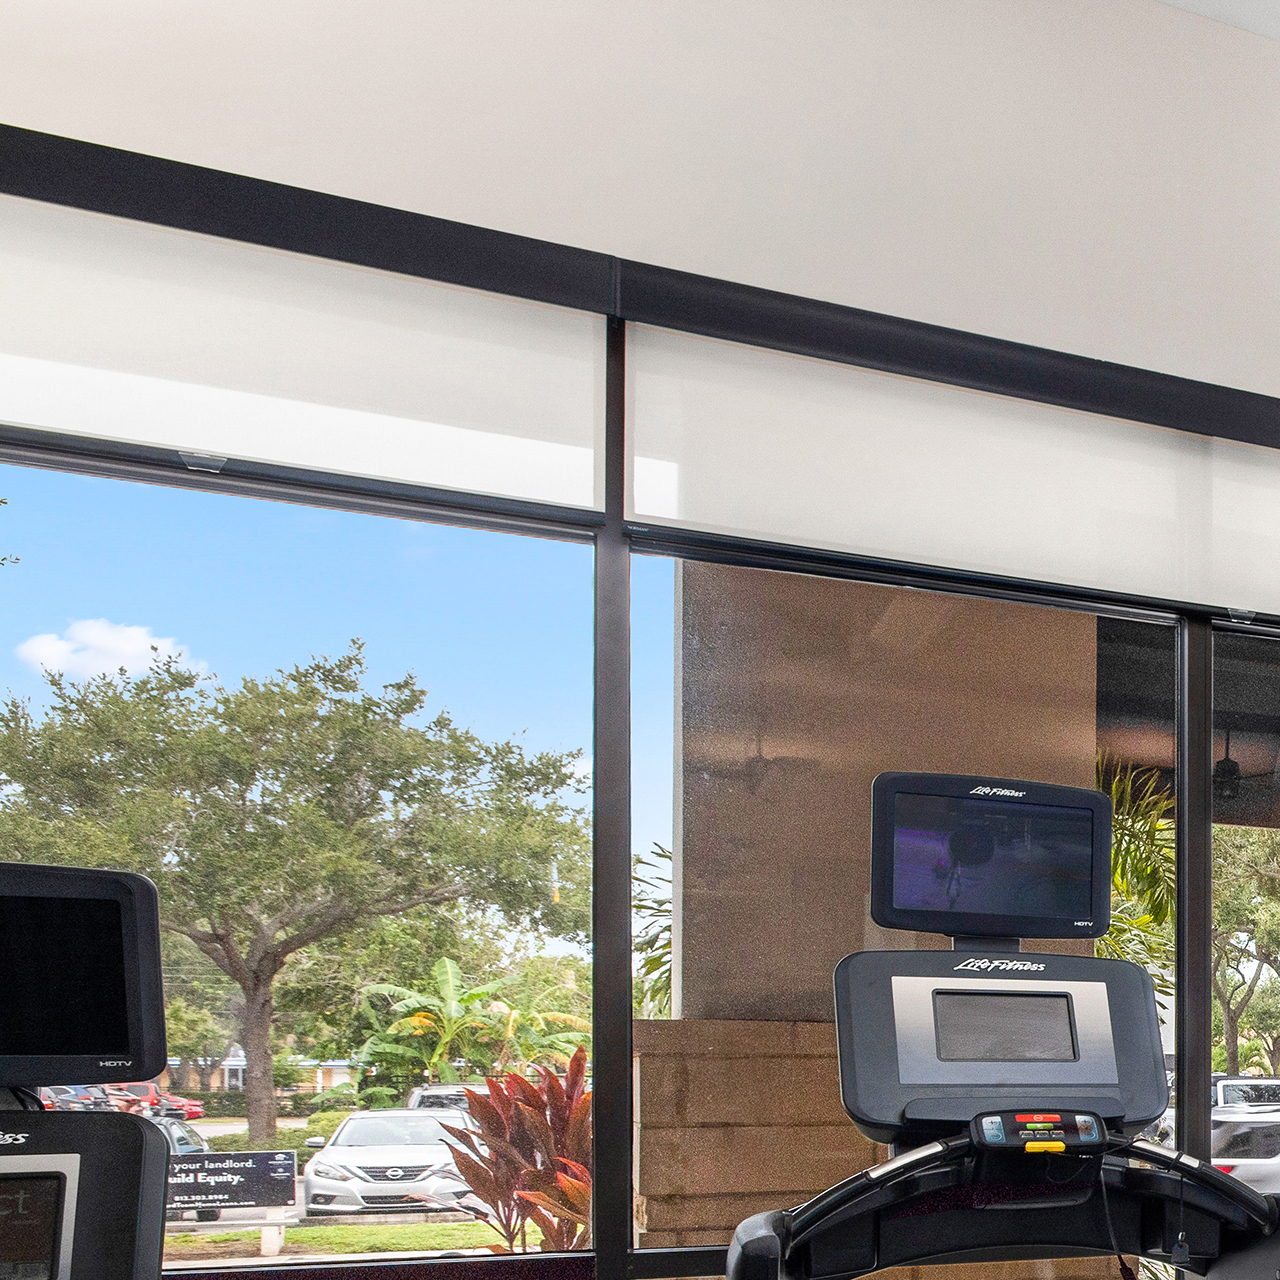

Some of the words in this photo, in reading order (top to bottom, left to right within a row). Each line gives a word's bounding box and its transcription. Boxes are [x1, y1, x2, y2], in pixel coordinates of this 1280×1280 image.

[990, 788, 1023, 798] Fitness
[953, 958, 991, 972] Life
[987, 959, 1046, 972] Fitness
[173, 1162, 202, 1172] your
[204, 1159, 257, 1169] landlord.
[167, 1173, 195, 1184] uild
[197, 1172, 245, 1186] Equity.
